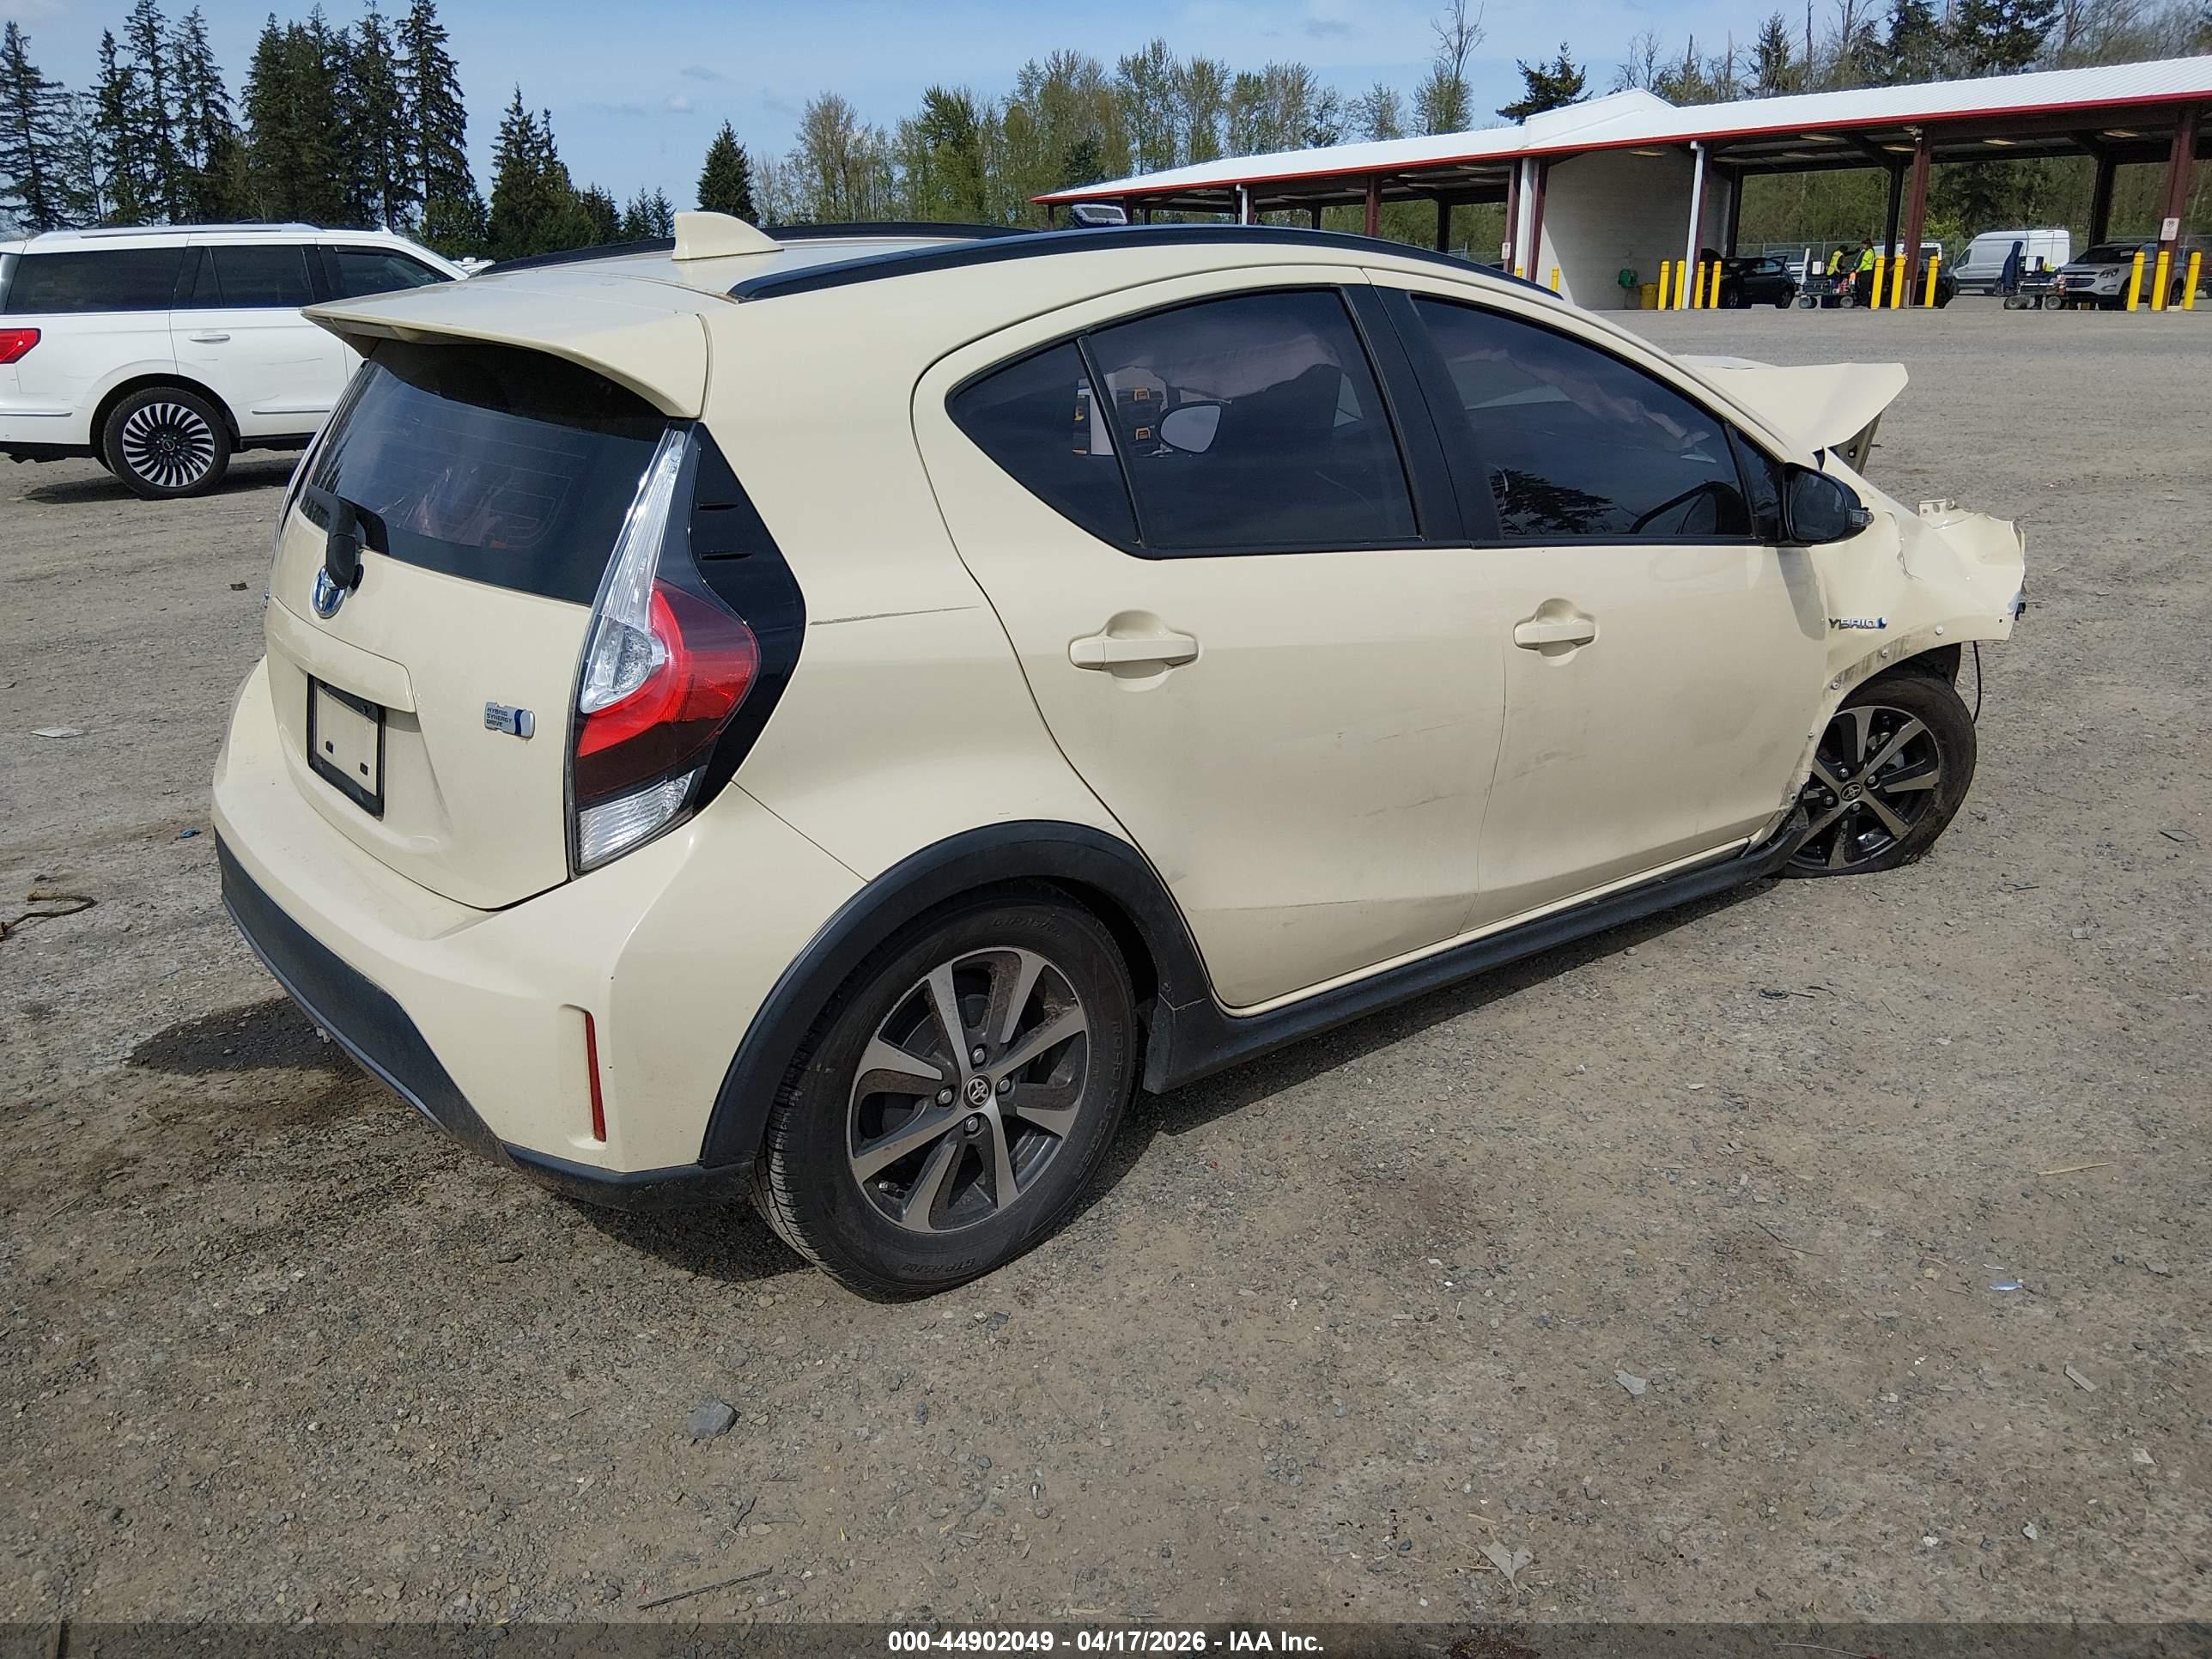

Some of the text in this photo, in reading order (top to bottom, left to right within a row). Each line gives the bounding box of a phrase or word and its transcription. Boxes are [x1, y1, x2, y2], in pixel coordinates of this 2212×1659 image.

[487, 707, 508, 716] HYBRID
[486, 713, 513, 724] SYNERGY
[486, 719, 503, 727] DRIVE
